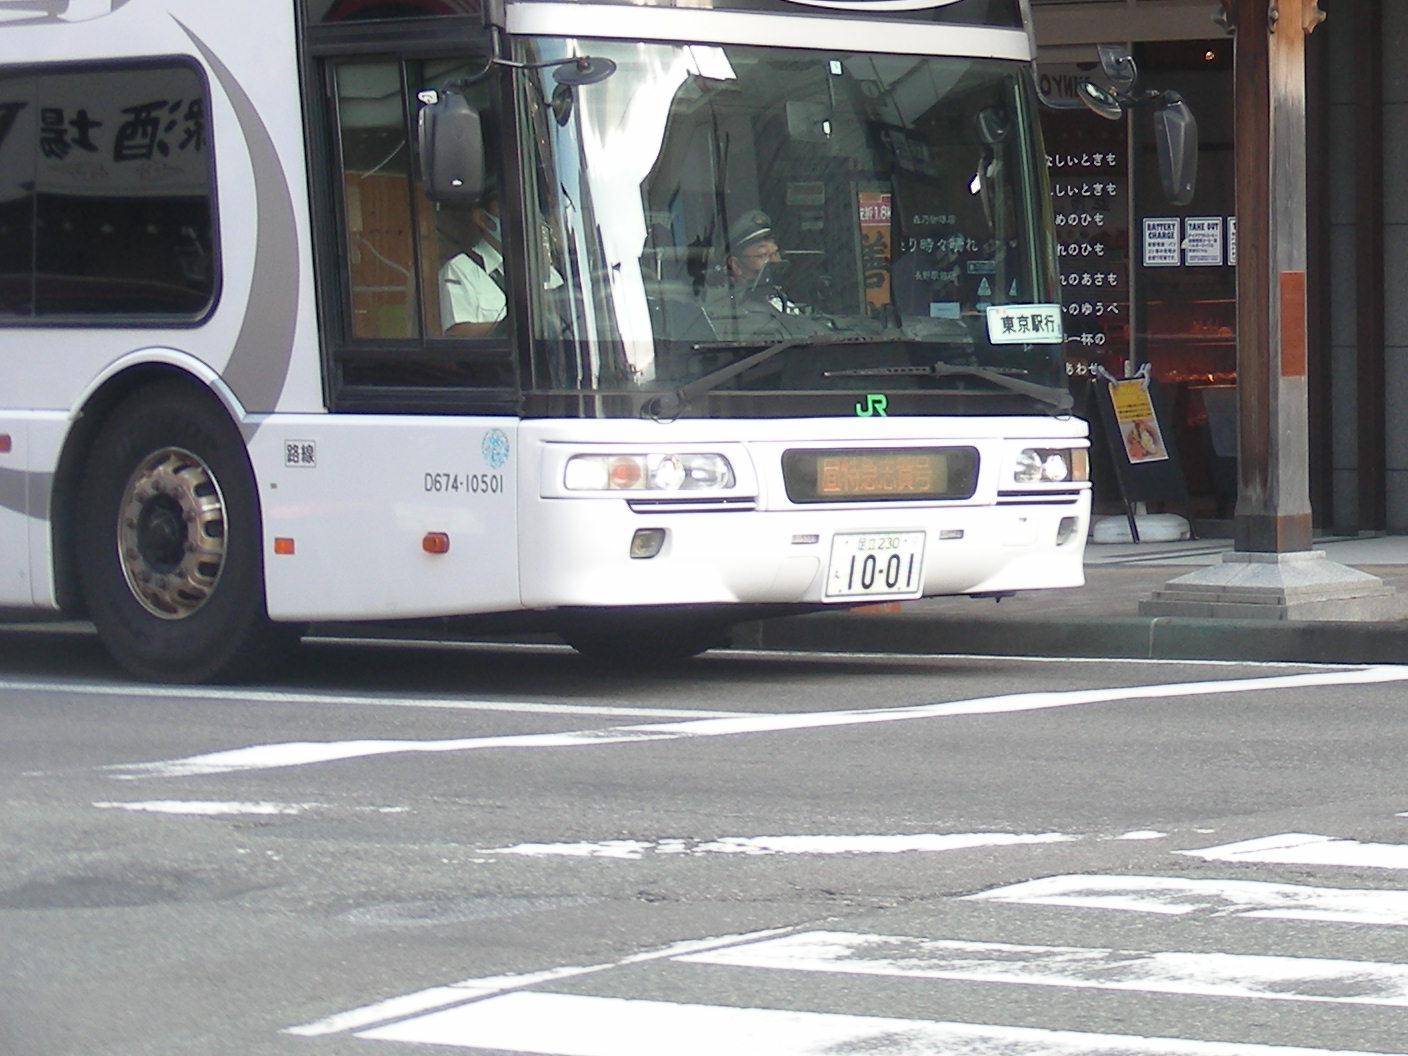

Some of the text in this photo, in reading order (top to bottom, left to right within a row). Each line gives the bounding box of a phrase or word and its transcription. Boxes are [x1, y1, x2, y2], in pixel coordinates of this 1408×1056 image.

[1052, 183, 1117, 197] しいときも
[1147, 223, 1176, 231] BATTERY
[1188, 223, 1219, 231] TAKE OUT
[1147, 231, 1174, 239] CHARGE
[1062, 301, 1119, 315] のゆうべ
[1000, 315, 1055, 335] 東京駅行
[1064, 331, 1106, 346] 一杯の
[855, 394, 888, 418] JR
[287, 444, 315, 464] 路線
[425, 473, 503, 493] D674-10501
